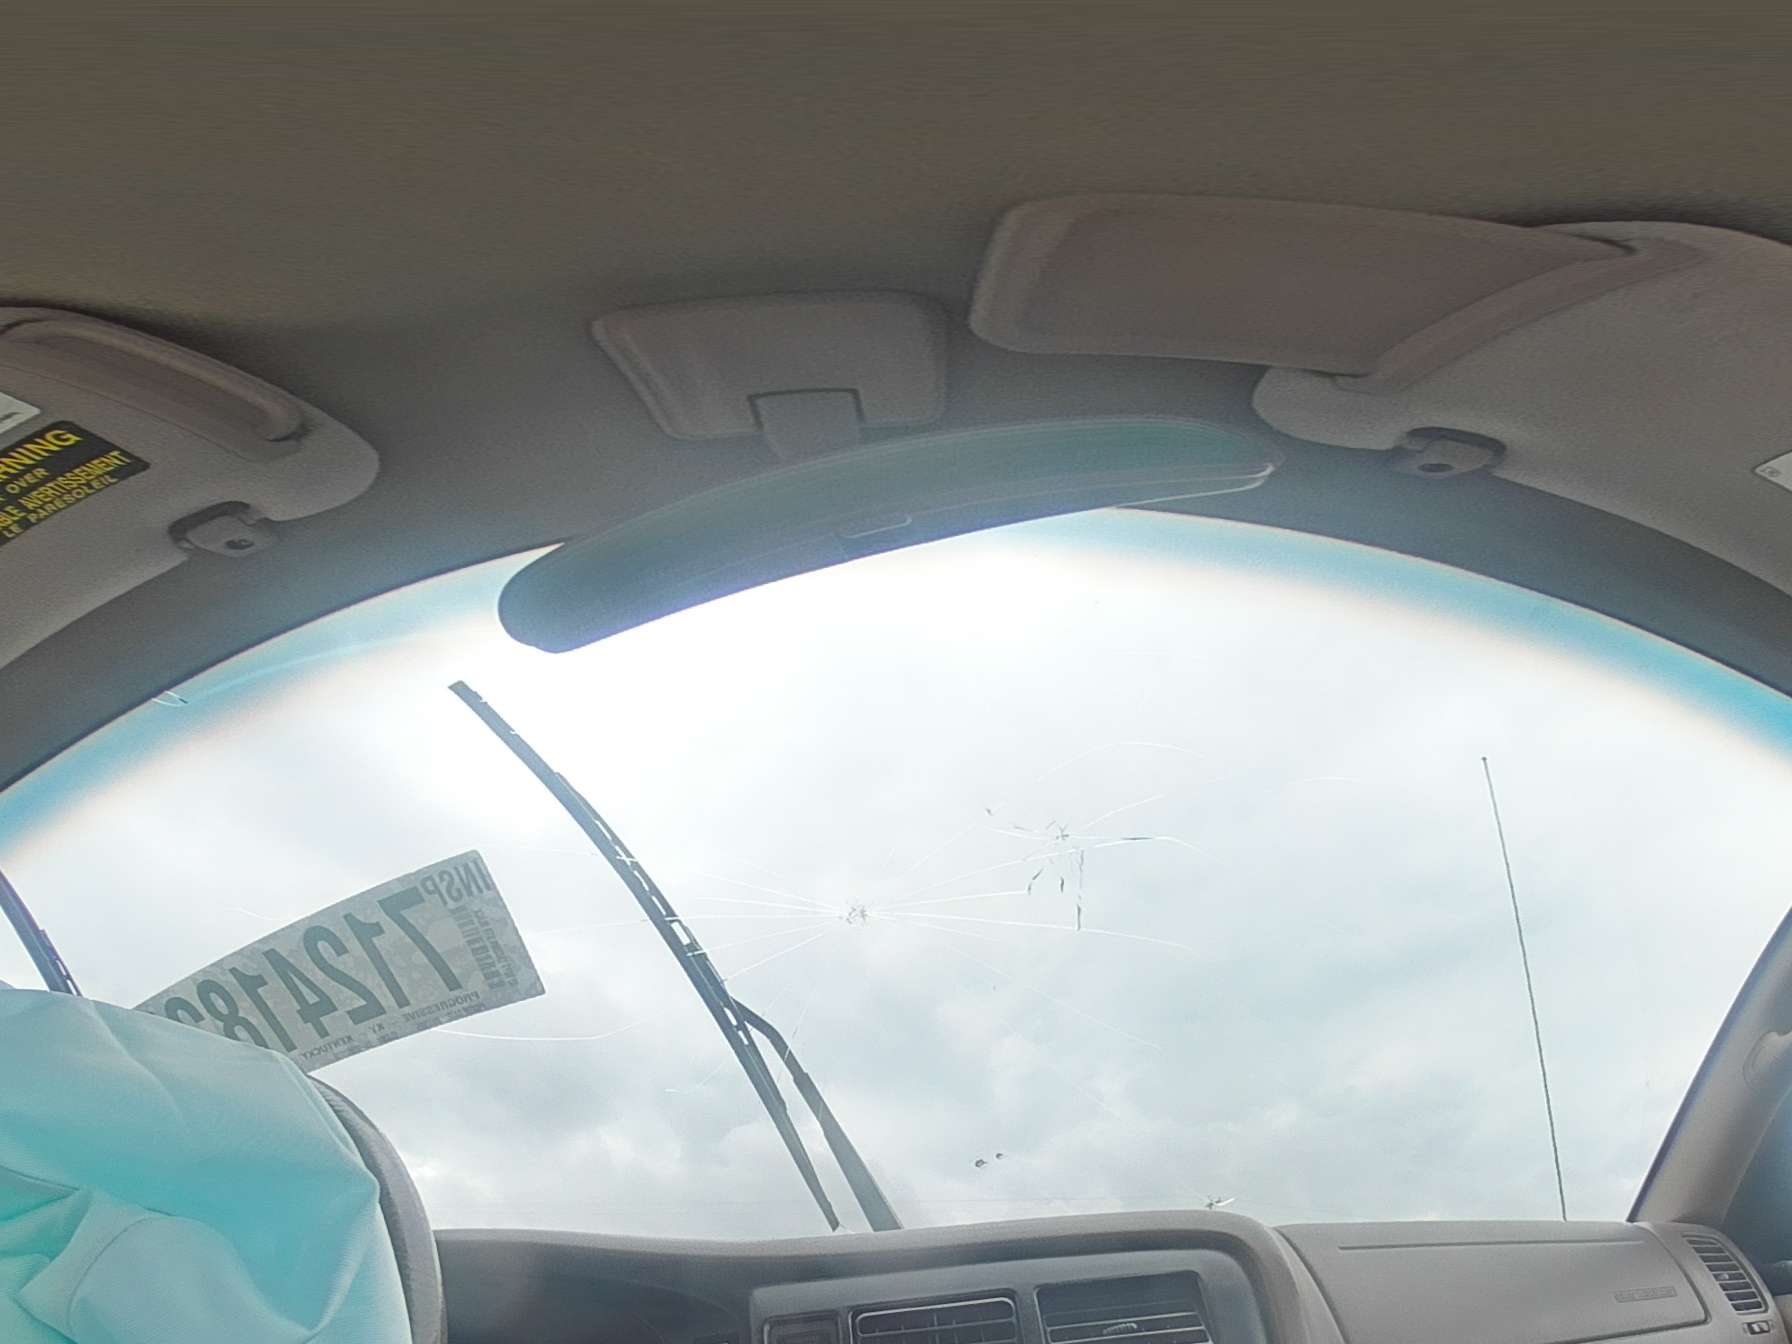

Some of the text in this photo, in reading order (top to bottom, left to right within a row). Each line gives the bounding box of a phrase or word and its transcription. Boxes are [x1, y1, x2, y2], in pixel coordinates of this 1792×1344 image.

[4, 467, 50, 495] OVER
[18, 450, 132, 511] AVERTISSEMENT
[5, 524, 24, 538] LE
